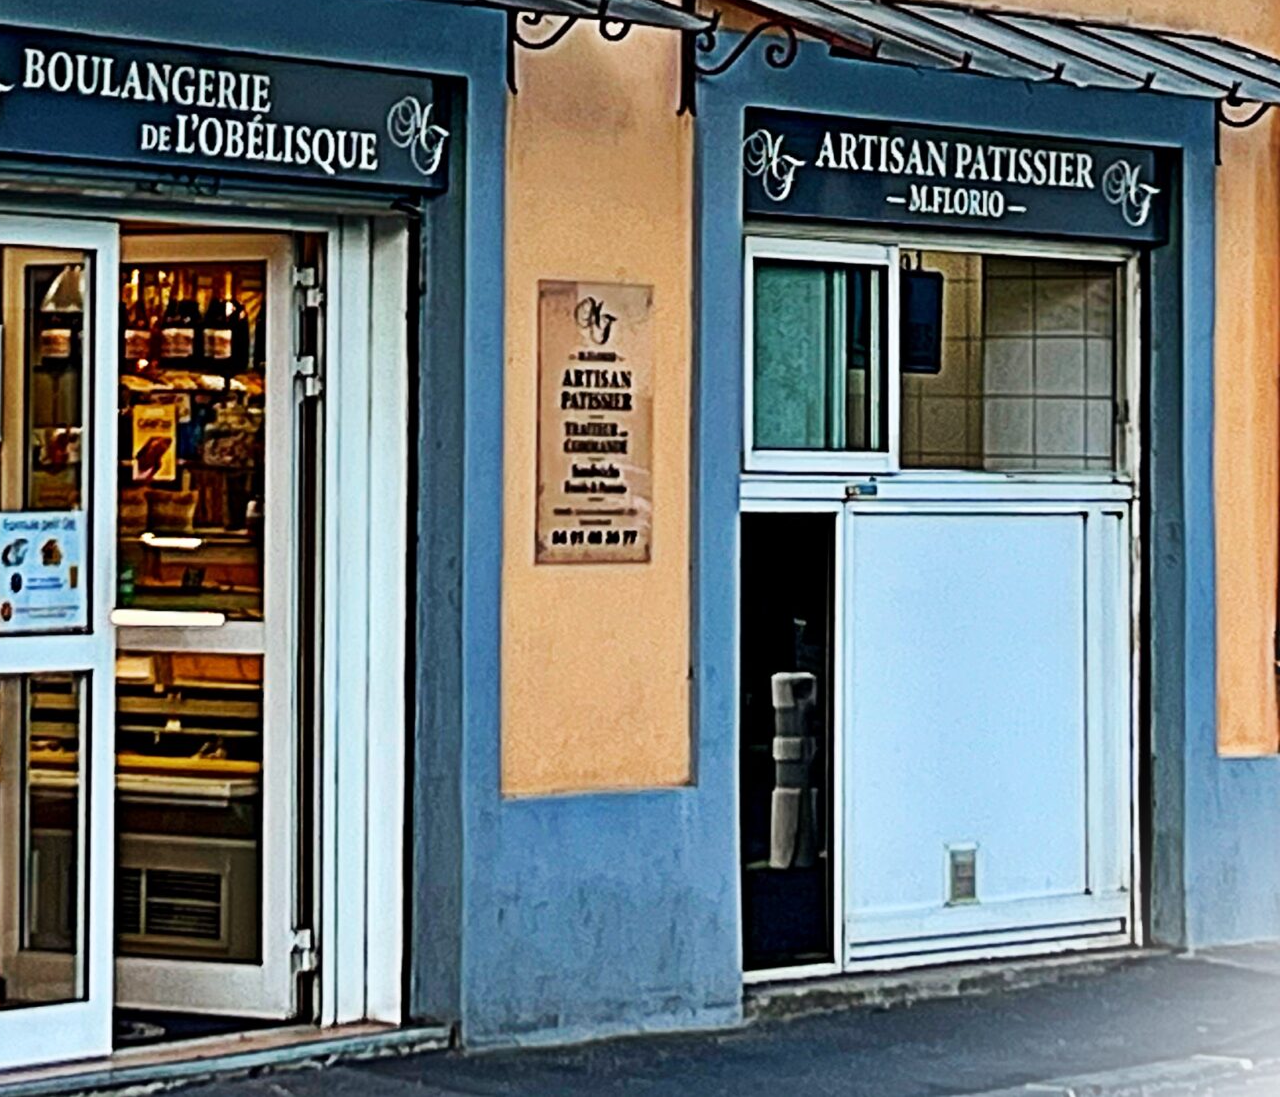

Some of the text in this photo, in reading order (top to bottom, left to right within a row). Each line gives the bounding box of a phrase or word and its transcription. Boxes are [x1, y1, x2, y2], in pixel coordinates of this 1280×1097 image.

[22, 47, 272, 114] BOULANGERIE
[174, 113, 379, 175] L'OBÉLISQUE
[815, 131, 1096, 190] ARTISAN PATISSIER
[561, 391, 632, 412] PATISSIER
[562, 369, 632, 388] ARTISAN
